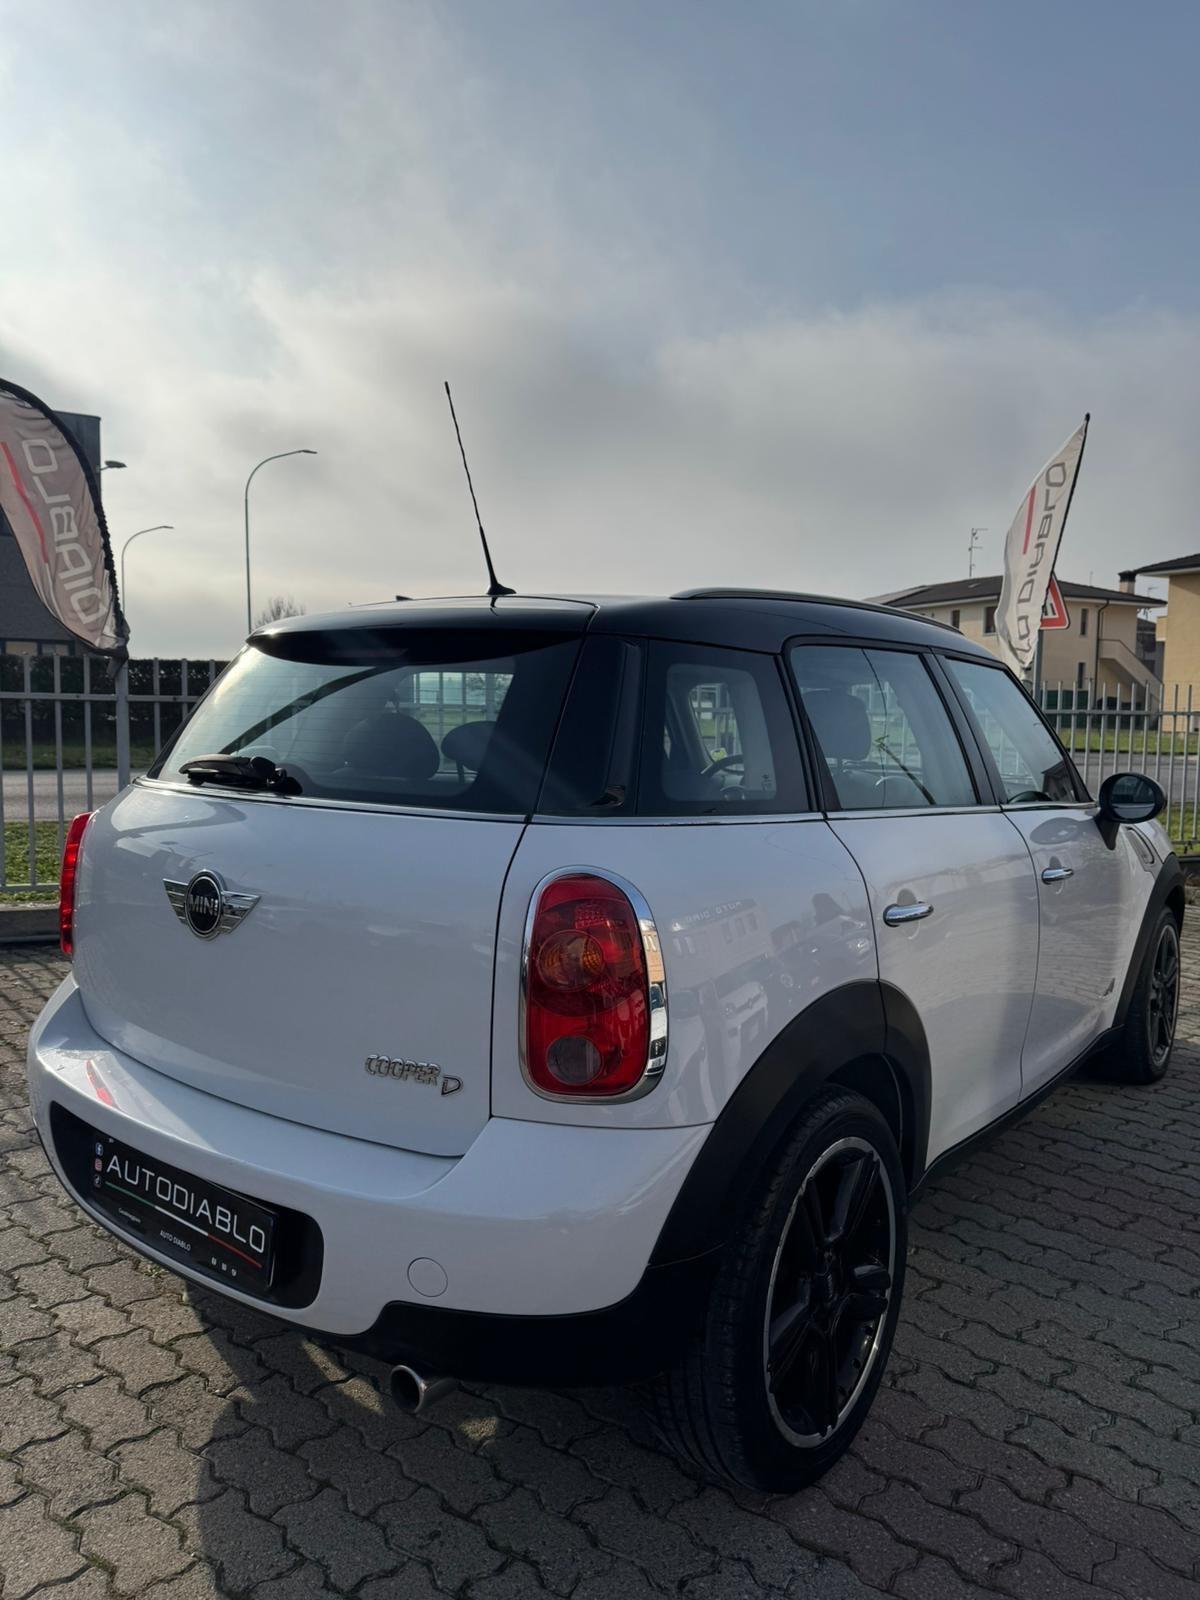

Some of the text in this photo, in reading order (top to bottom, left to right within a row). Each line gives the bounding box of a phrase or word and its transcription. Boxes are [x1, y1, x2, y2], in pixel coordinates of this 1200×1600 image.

[189, 894, 219, 917] MINI
[365, 1054, 464, 1096] COOPER D
[106, 1155, 266, 1254] AUTODIABLO
[160, 1229, 192, 1252] AUTO DIABLO
